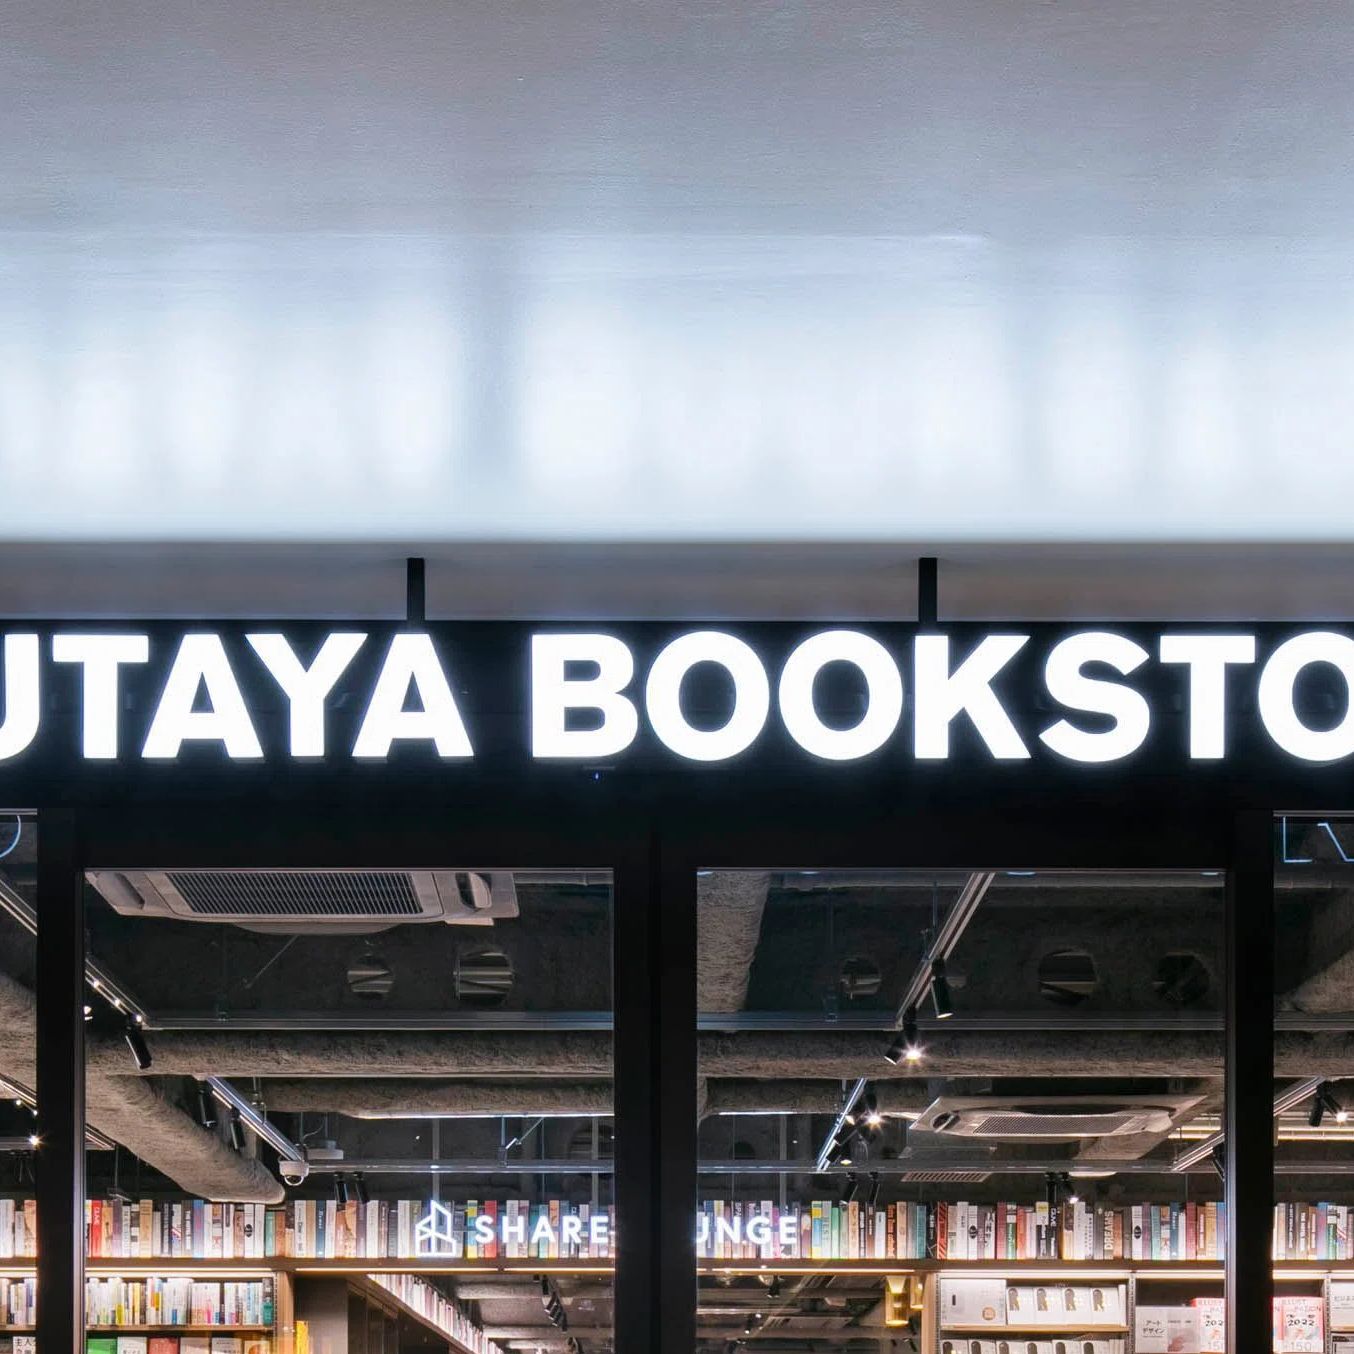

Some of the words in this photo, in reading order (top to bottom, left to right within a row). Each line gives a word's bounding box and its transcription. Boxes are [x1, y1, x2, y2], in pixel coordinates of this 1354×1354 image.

[474, 1215, 609, 1244] SHARE
[696, 1215, 799, 1245] UNGE
[1104, 1210, 1114, 1250] DREAMS
[1287, 1319, 1315, 1327] 2022
